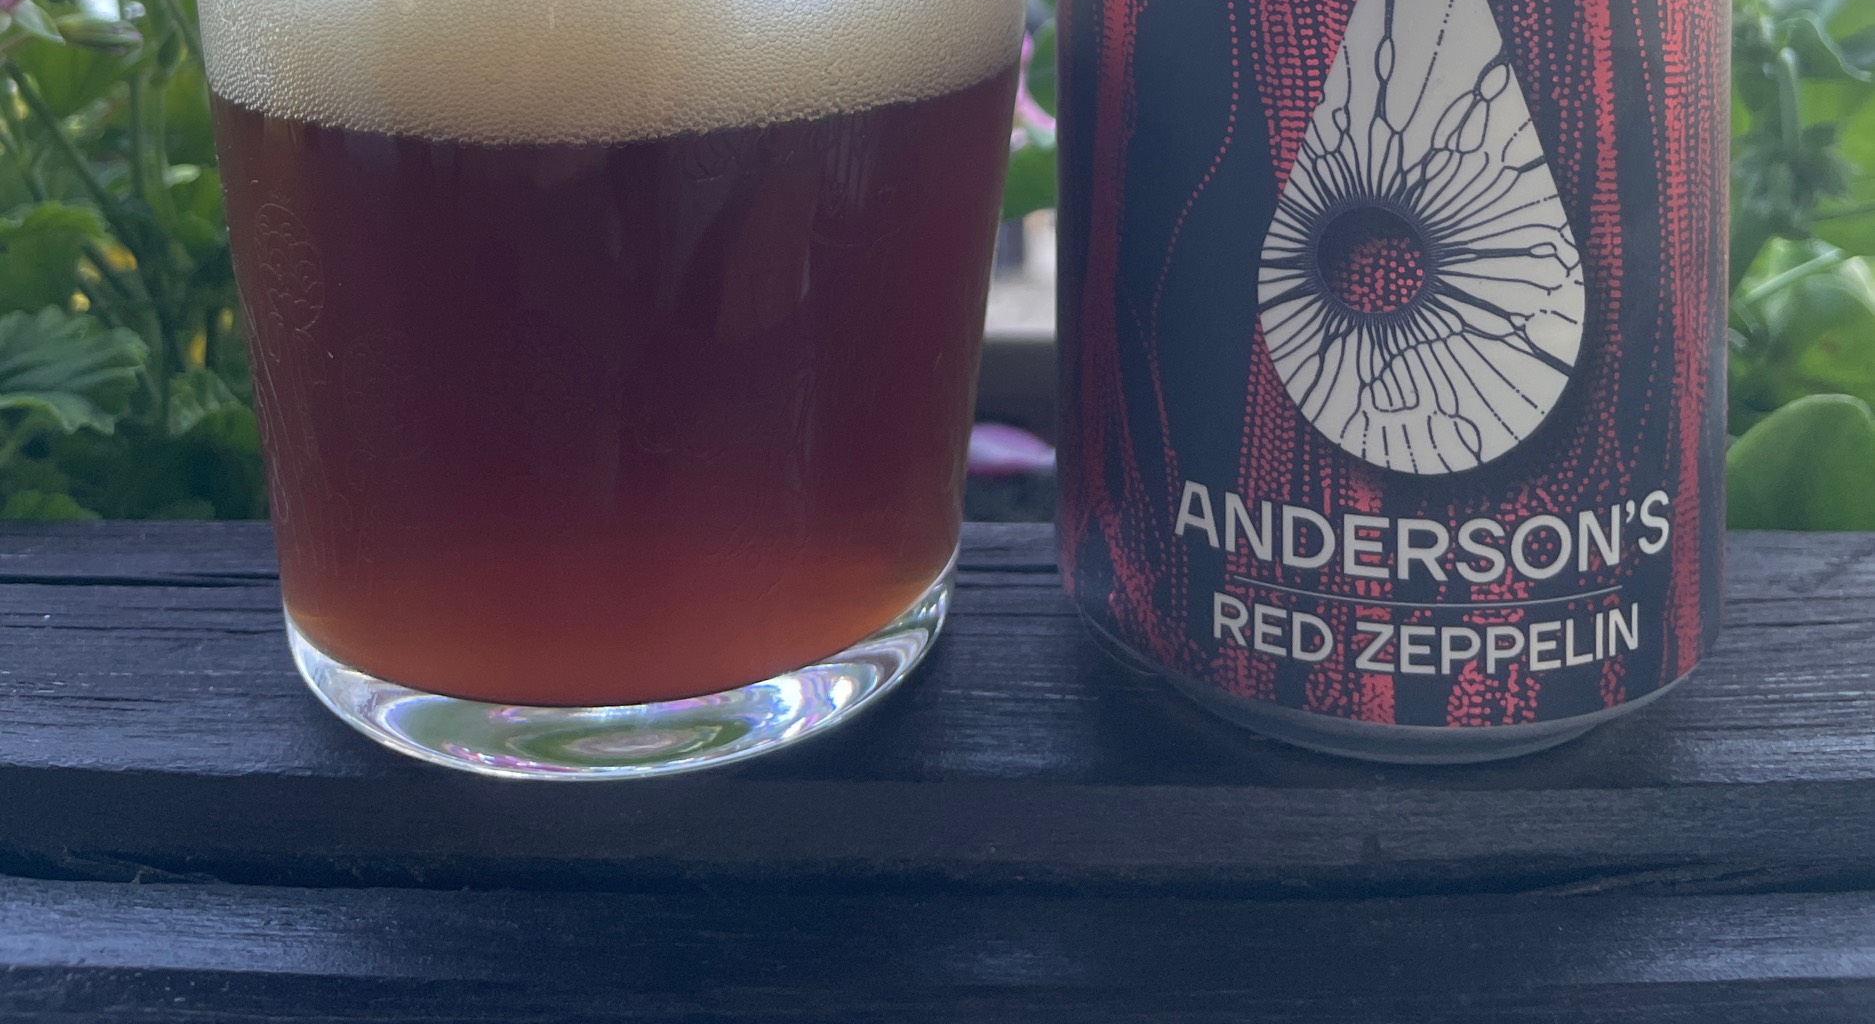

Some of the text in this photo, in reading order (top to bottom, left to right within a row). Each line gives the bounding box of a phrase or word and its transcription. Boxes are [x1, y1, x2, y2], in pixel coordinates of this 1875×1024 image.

[1174, 479, 1670, 583] ANDERSON'S
[1212, 592, 1640, 675] RED ZEPPELIN
